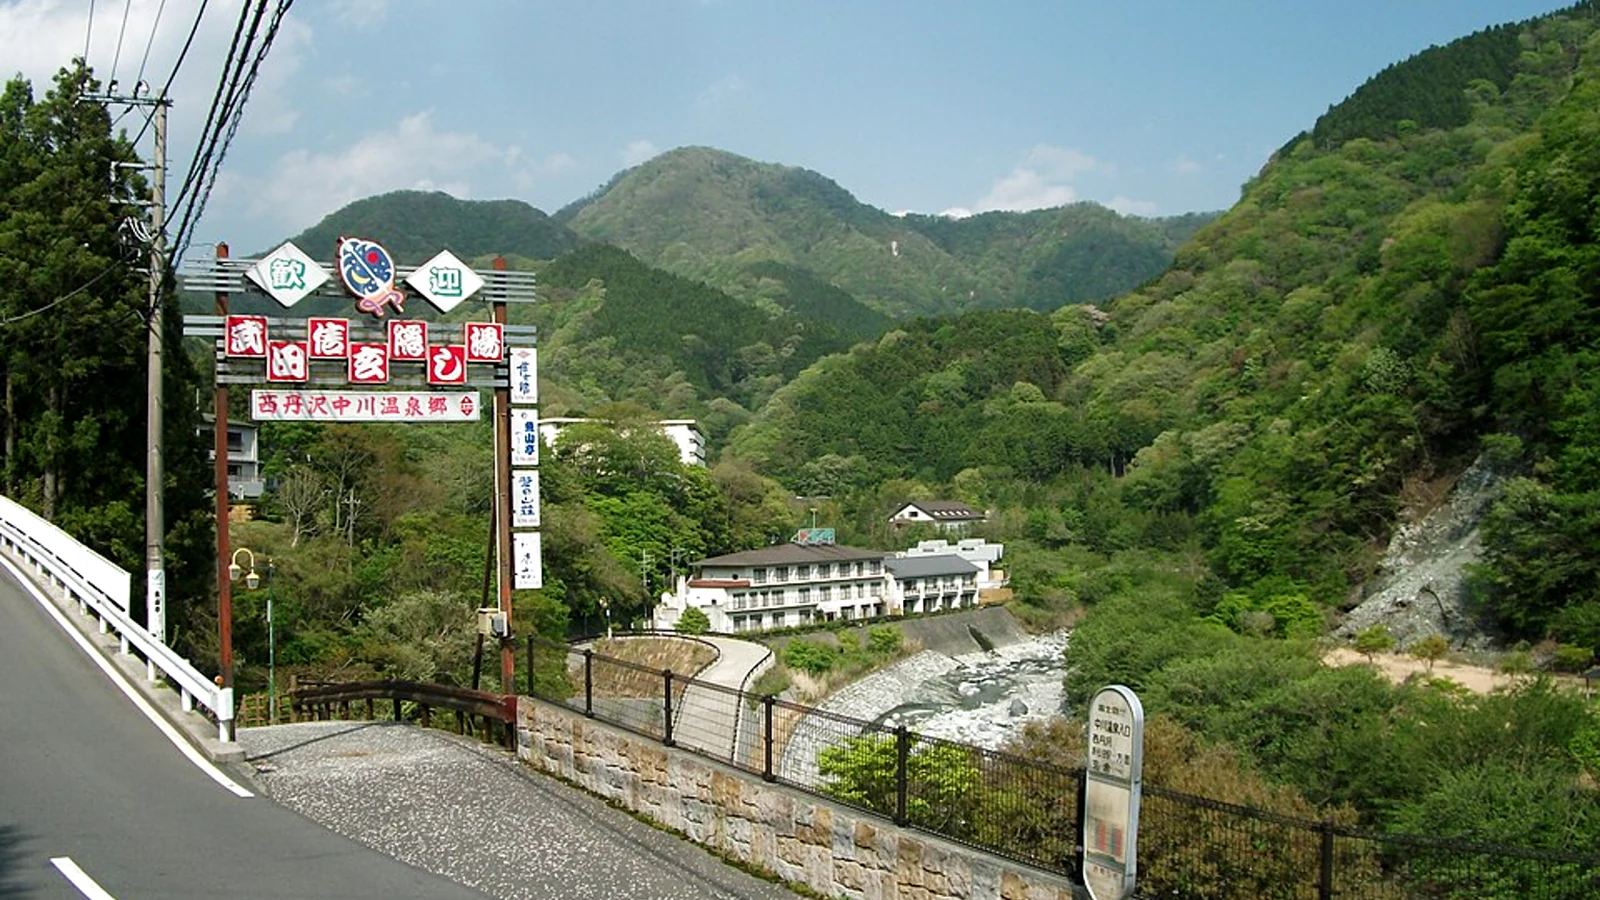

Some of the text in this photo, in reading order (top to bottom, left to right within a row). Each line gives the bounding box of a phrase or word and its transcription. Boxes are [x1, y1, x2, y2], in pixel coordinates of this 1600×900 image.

[270, 258, 463, 297] 歓 迎
[258, 395, 448, 417] 西丹沢中川温泉郷
